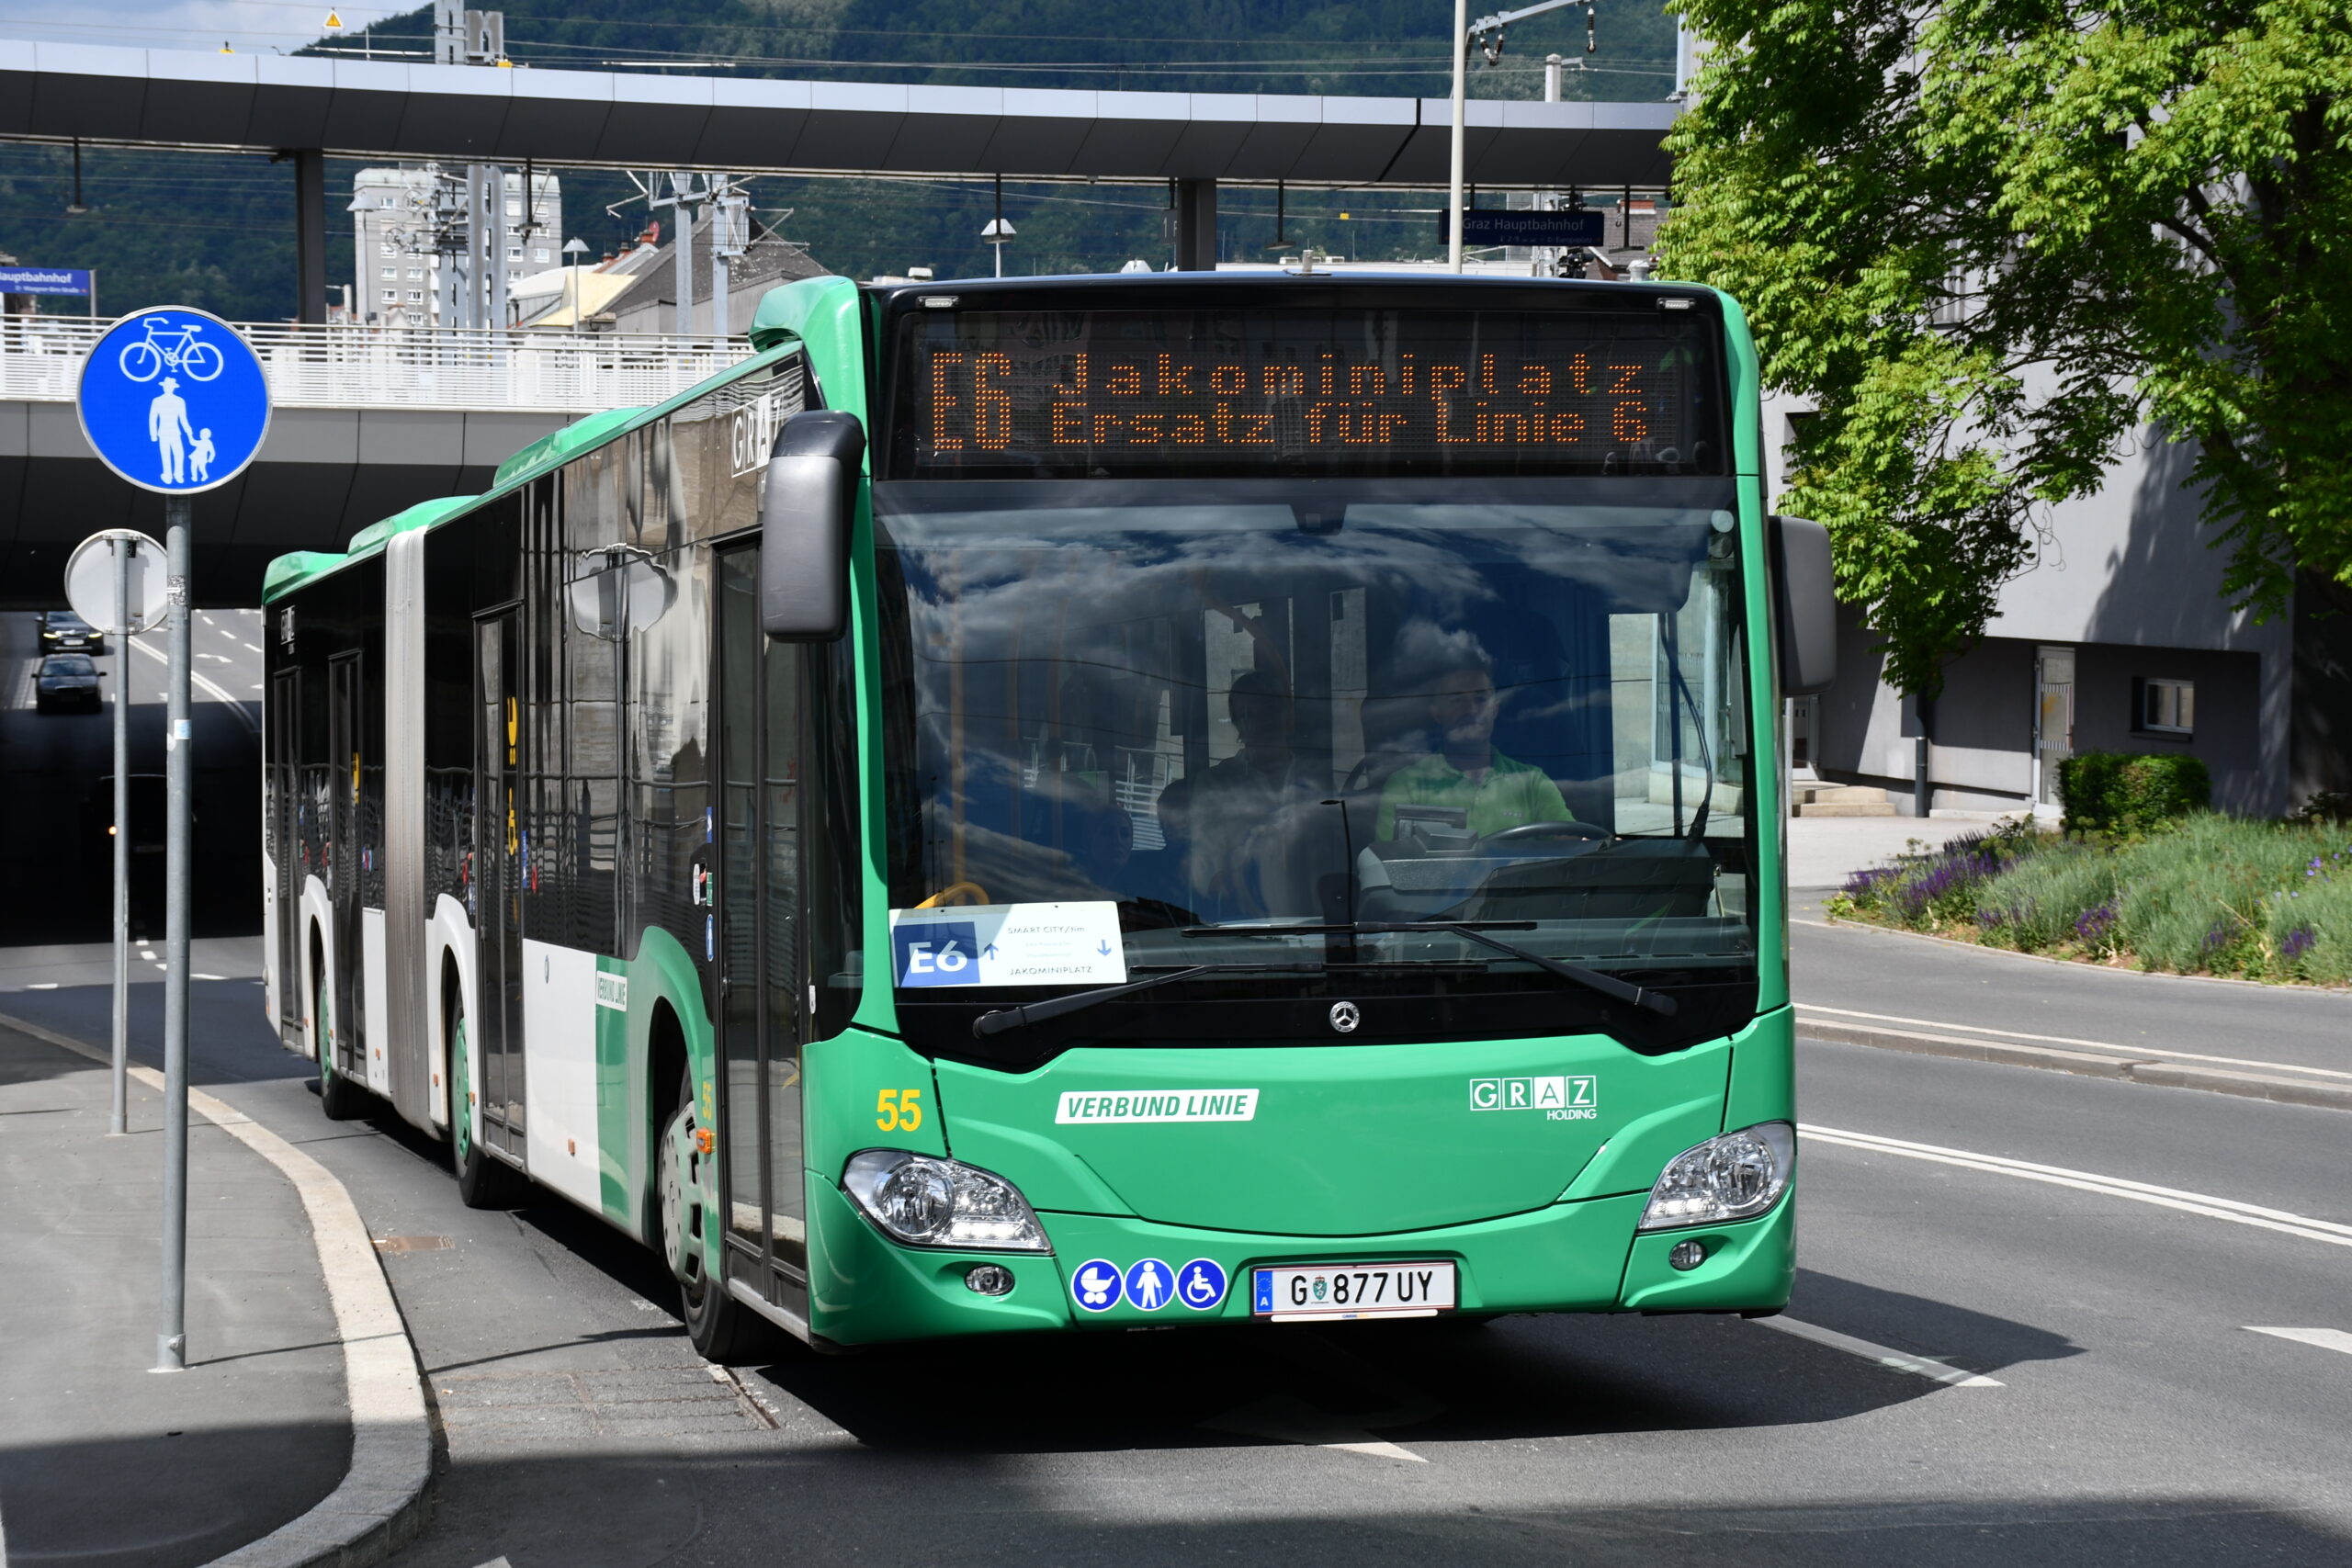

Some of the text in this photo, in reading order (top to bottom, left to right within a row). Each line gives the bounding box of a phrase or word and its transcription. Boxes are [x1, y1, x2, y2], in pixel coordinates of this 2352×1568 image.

[1463, 218, 1585, 233] Graz Hauptbahnhof
[0, 271, 73, 283] auptbahnhof
[1053, 353, 1643, 400] Jakominiplatz
[933, 353, 1011, 449] E6
[1053, 400, 1648, 443] Ersatz für Linie 6
[1007, 926, 1040, 934] SMART
[908, 939, 967, 974] E6
[1009, 965, 1093, 976] JAKOMINIPLATZ
[1473, 1078, 1590, 1108] GRAZ
[876, 1089, 922, 1132] 55
[1068, 1095, 1248, 1118] VERBUND LINIE
[1546, 1109, 1597, 1121] HOLDING
[1291, 1270, 1433, 1306] G 877 UY
[1260, 1296, 1270, 1307] A
